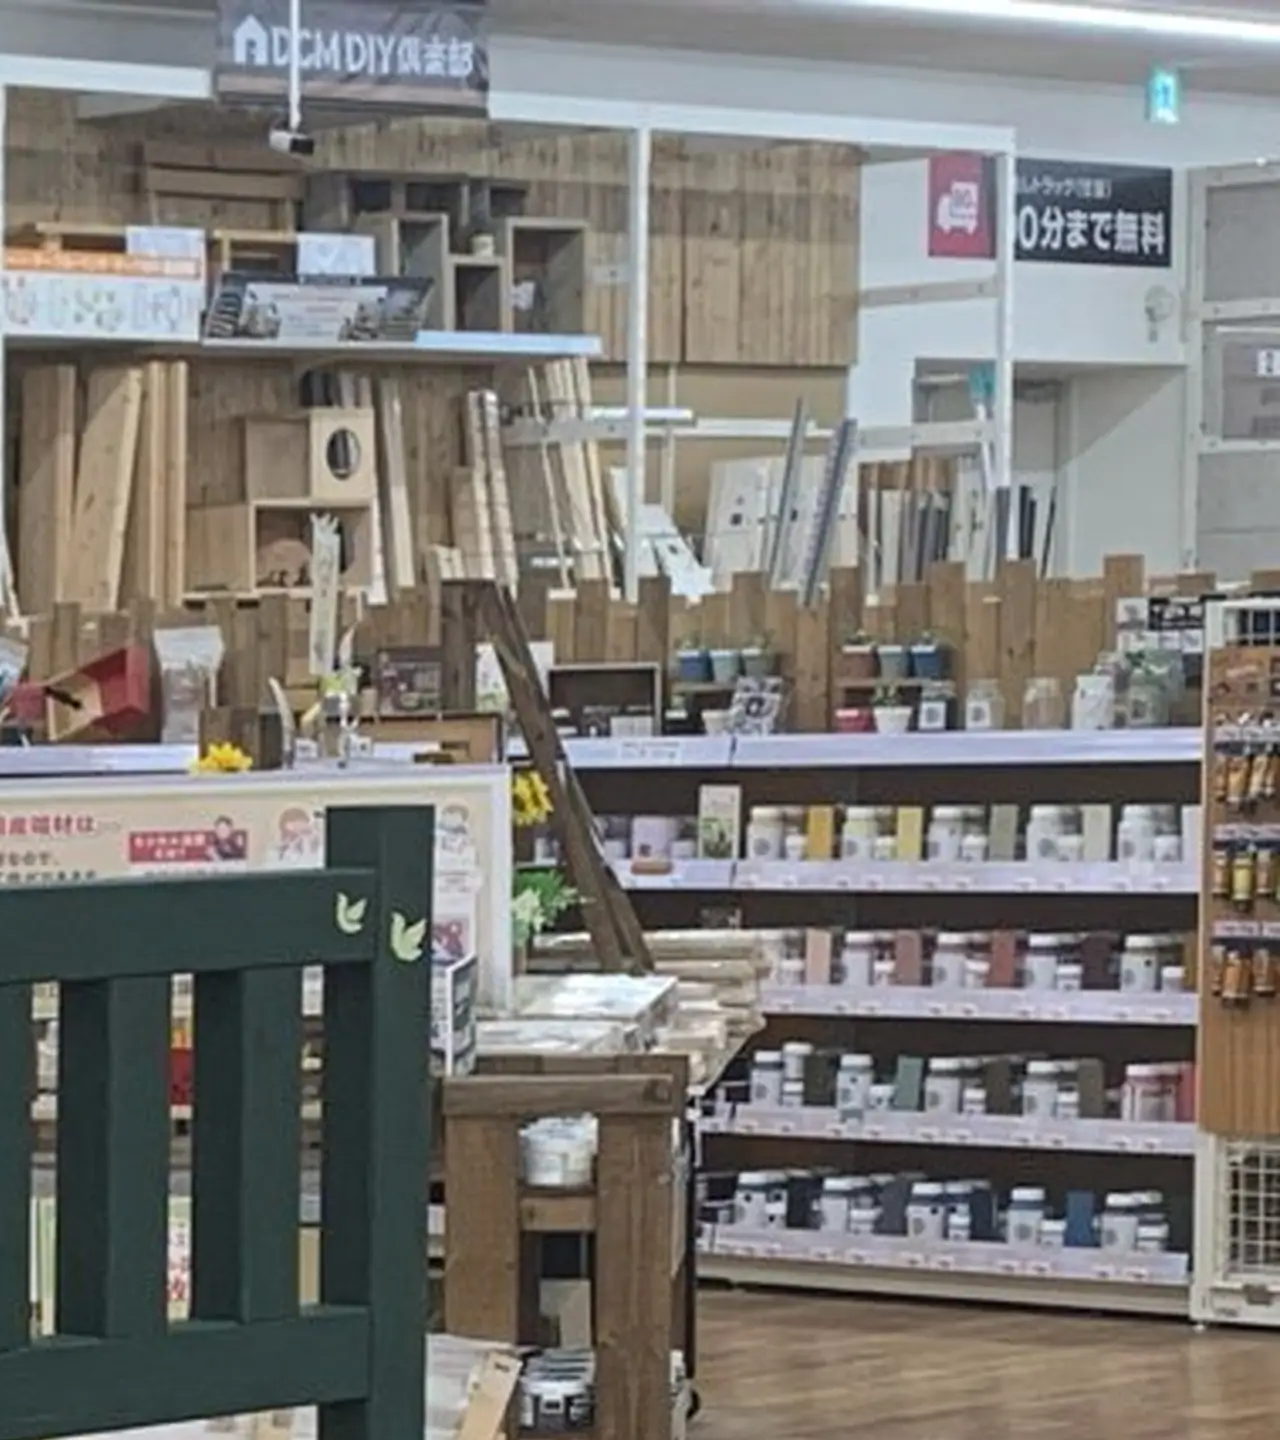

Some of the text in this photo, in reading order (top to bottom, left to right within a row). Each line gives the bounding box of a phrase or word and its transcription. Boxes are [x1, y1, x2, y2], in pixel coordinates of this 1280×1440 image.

[1018, 203, 1166, 256] 0分まで無料
